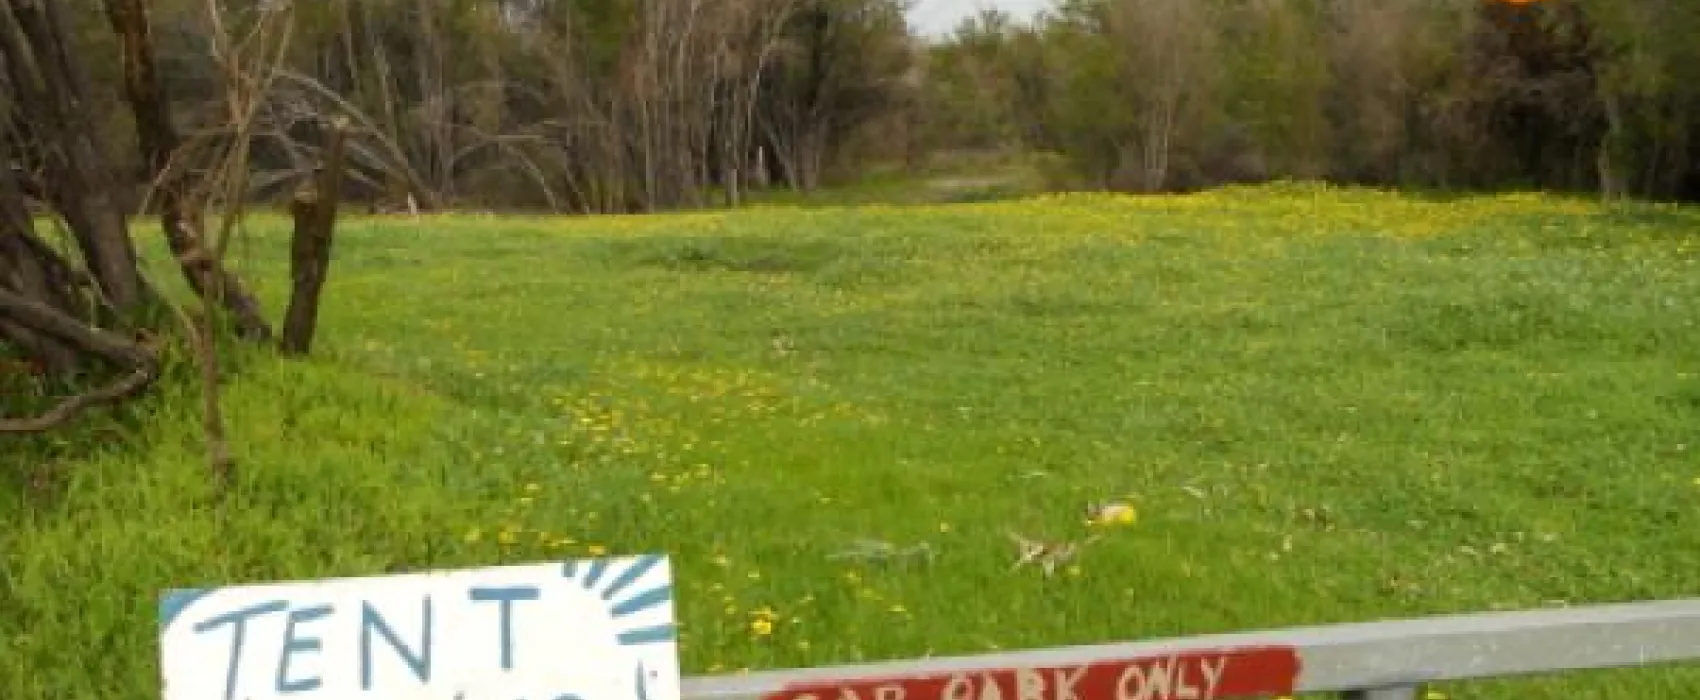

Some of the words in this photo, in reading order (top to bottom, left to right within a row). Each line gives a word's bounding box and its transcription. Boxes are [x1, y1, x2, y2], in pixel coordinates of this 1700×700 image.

[193, 586, 540, 700] TENT
[942, 666, 1090, 700] PARK
[1116, 655, 1227, 700] ONLY
